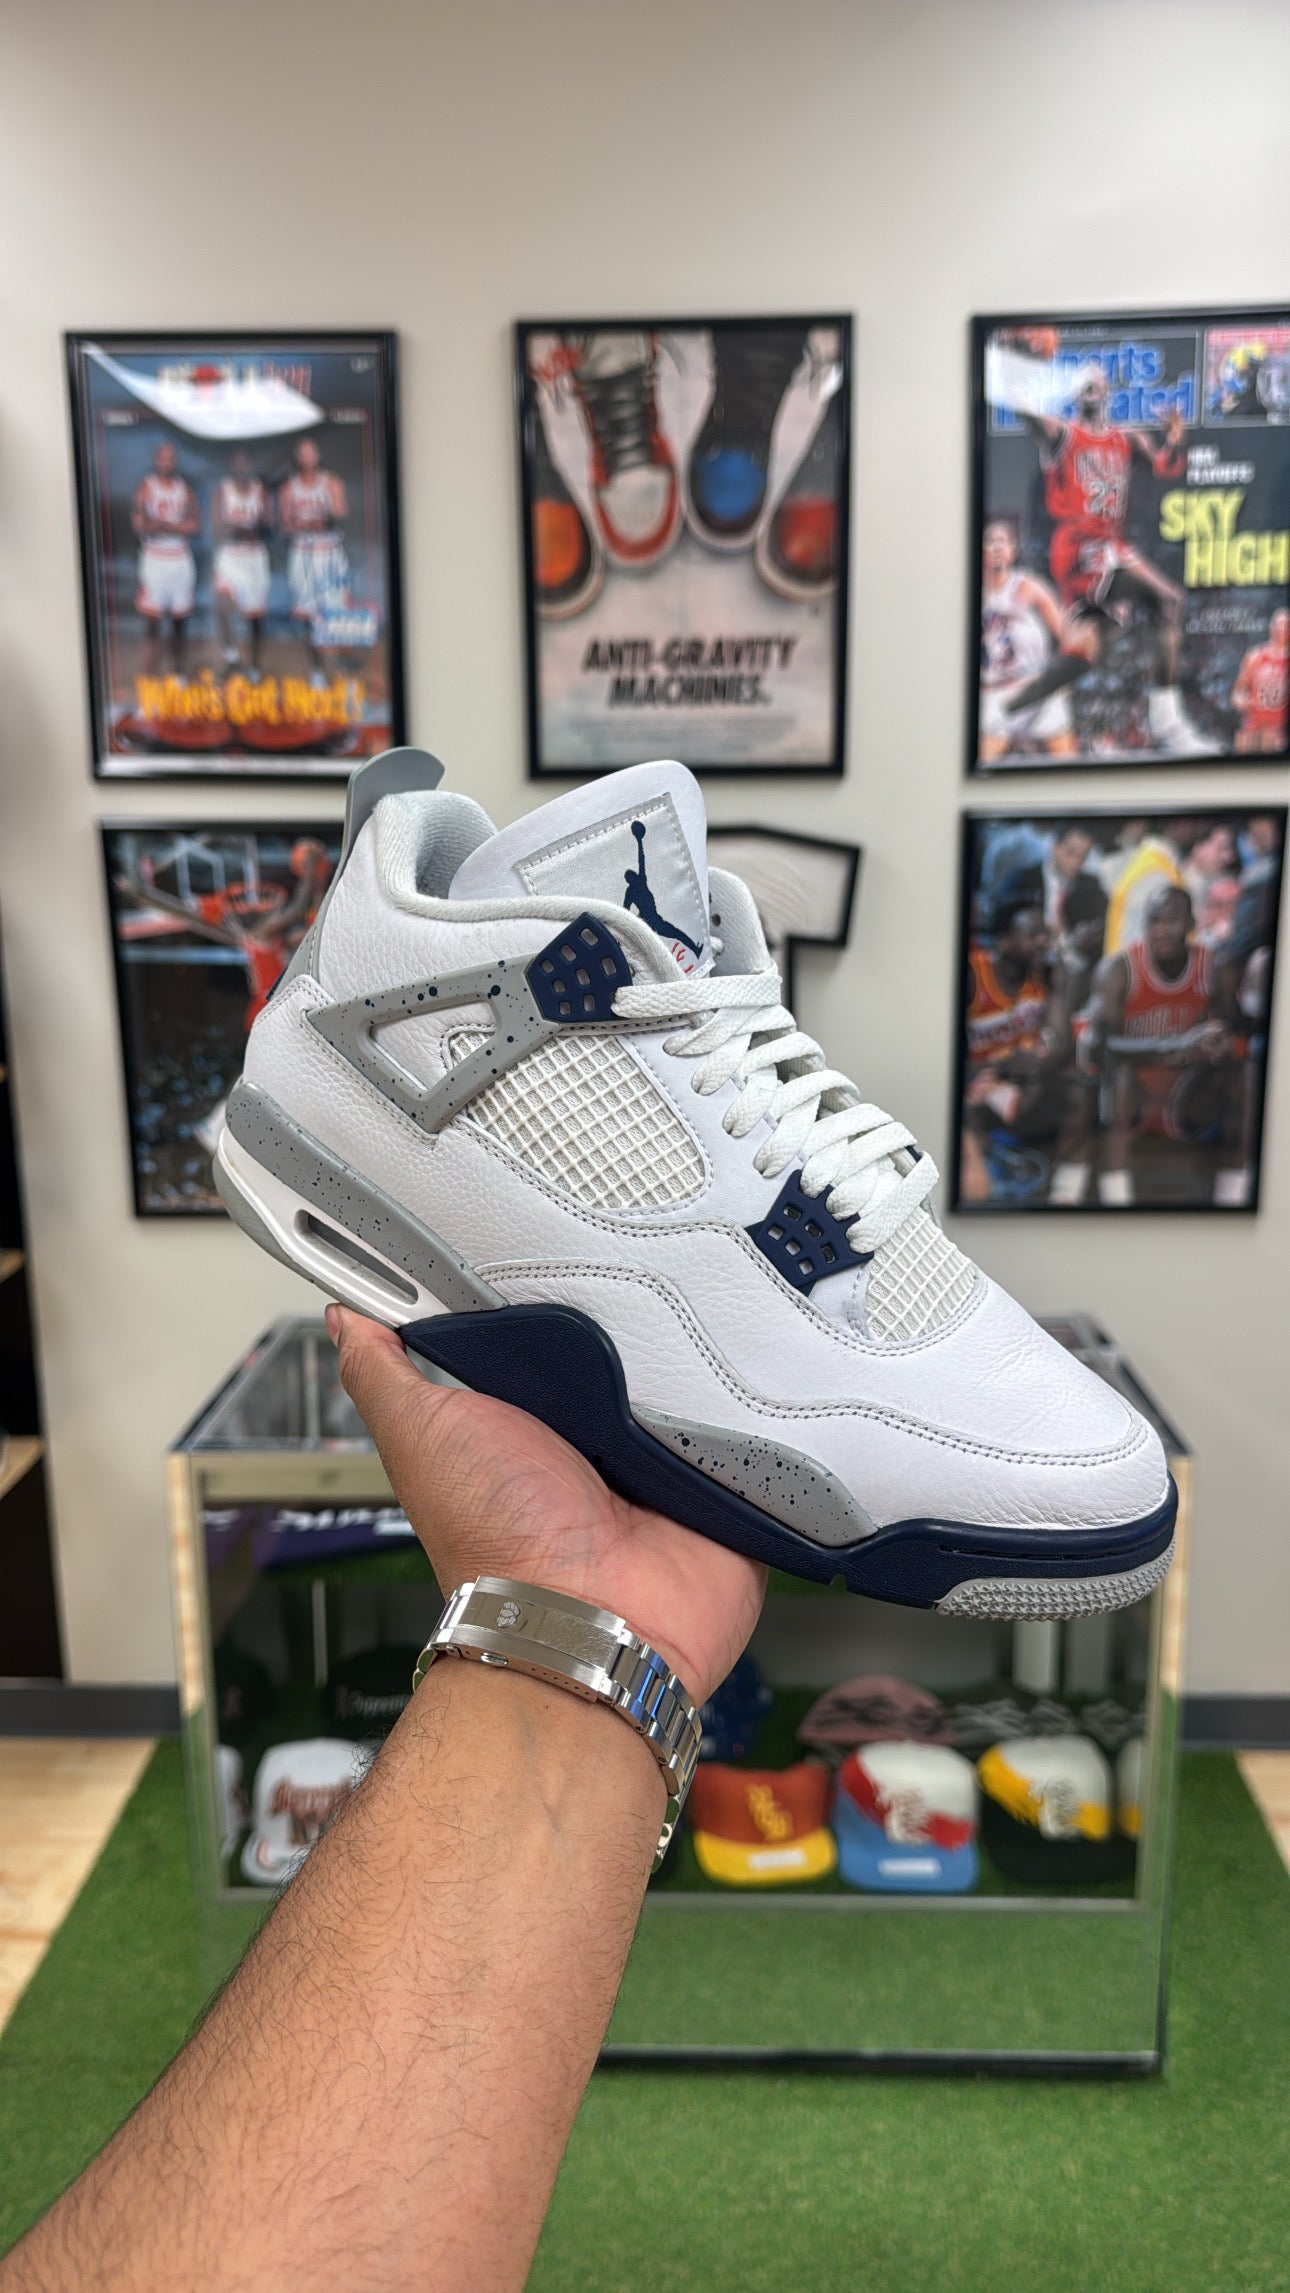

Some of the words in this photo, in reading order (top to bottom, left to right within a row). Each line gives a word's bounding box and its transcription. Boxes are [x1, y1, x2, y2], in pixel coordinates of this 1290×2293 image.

[1160, 488, 1246, 541] SKY
[1183, 532, 1290, 588] HIGH
[583, 636, 796, 670] ANTI-GRAVITY
